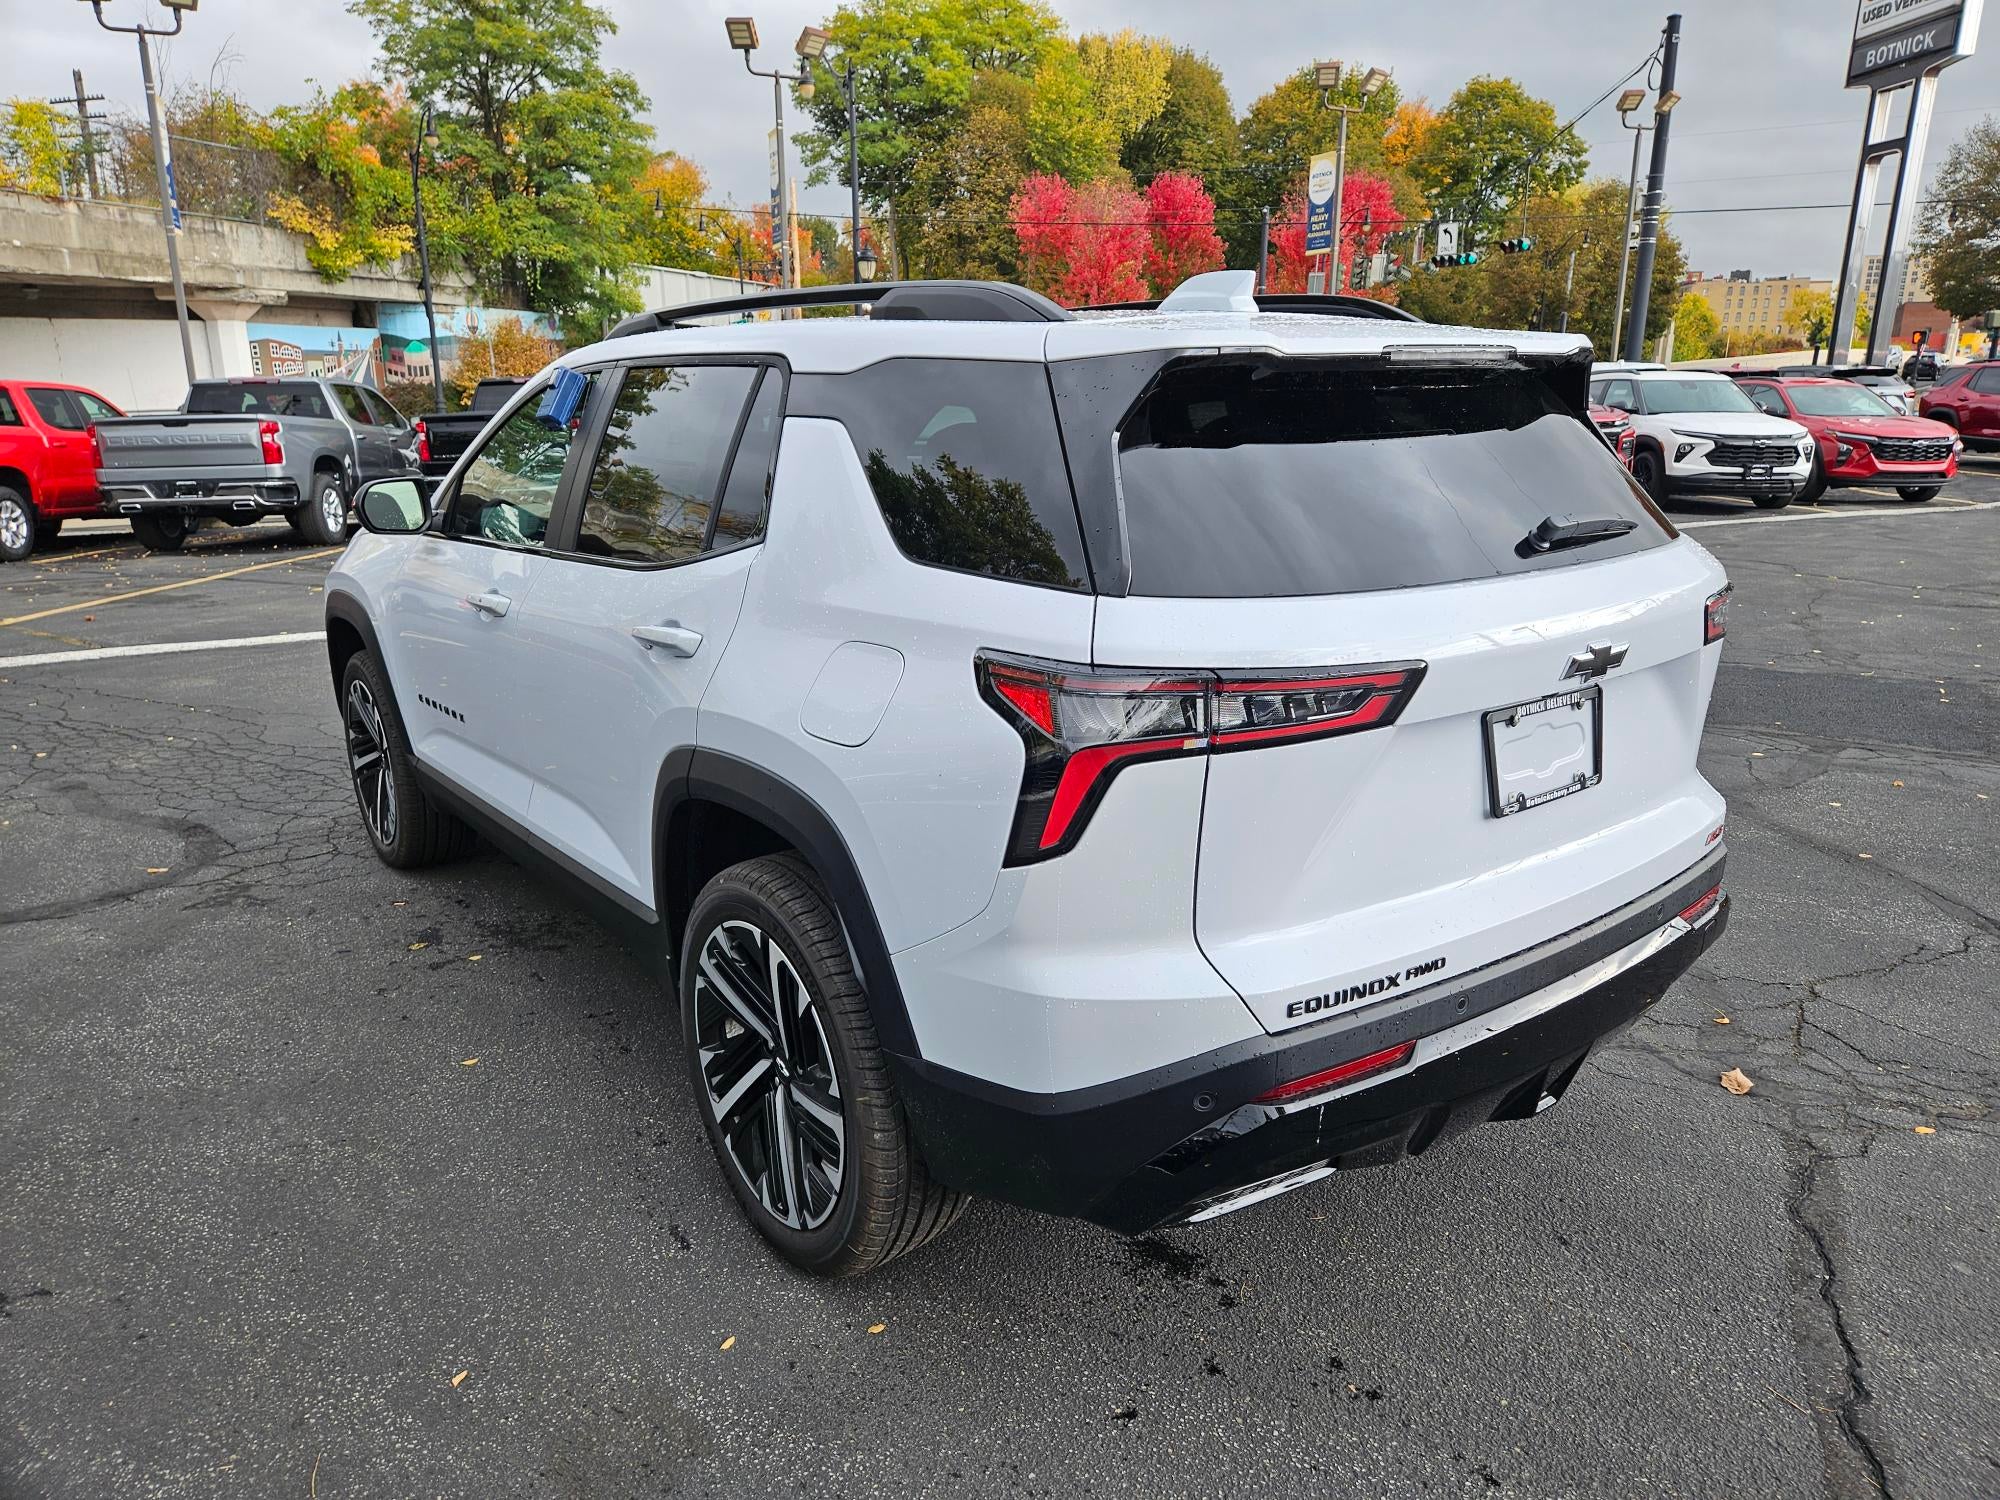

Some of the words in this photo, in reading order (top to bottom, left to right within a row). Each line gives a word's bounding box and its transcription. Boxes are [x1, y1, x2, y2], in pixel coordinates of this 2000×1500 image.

[1862, 1, 1893, 24] USED
[1895, 0, 1928, 12] VEH
[1865, 29, 1936, 68] BOTNICK
[1310, 213, 1329, 223] HEAVY
[1311, 222, 1327, 231] DUTY
[106, 433, 248, 448] CHEVROLET
[1517, 700, 1545, 717] BOTNICK
[1546, 693, 1571, 709] BELIEVE
[1526, 783, 1581, 807] Botnickchevy.com
[1286, 972, 1401, 1018] EQUINOX
[1405, 957, 1447, 980] AWD
